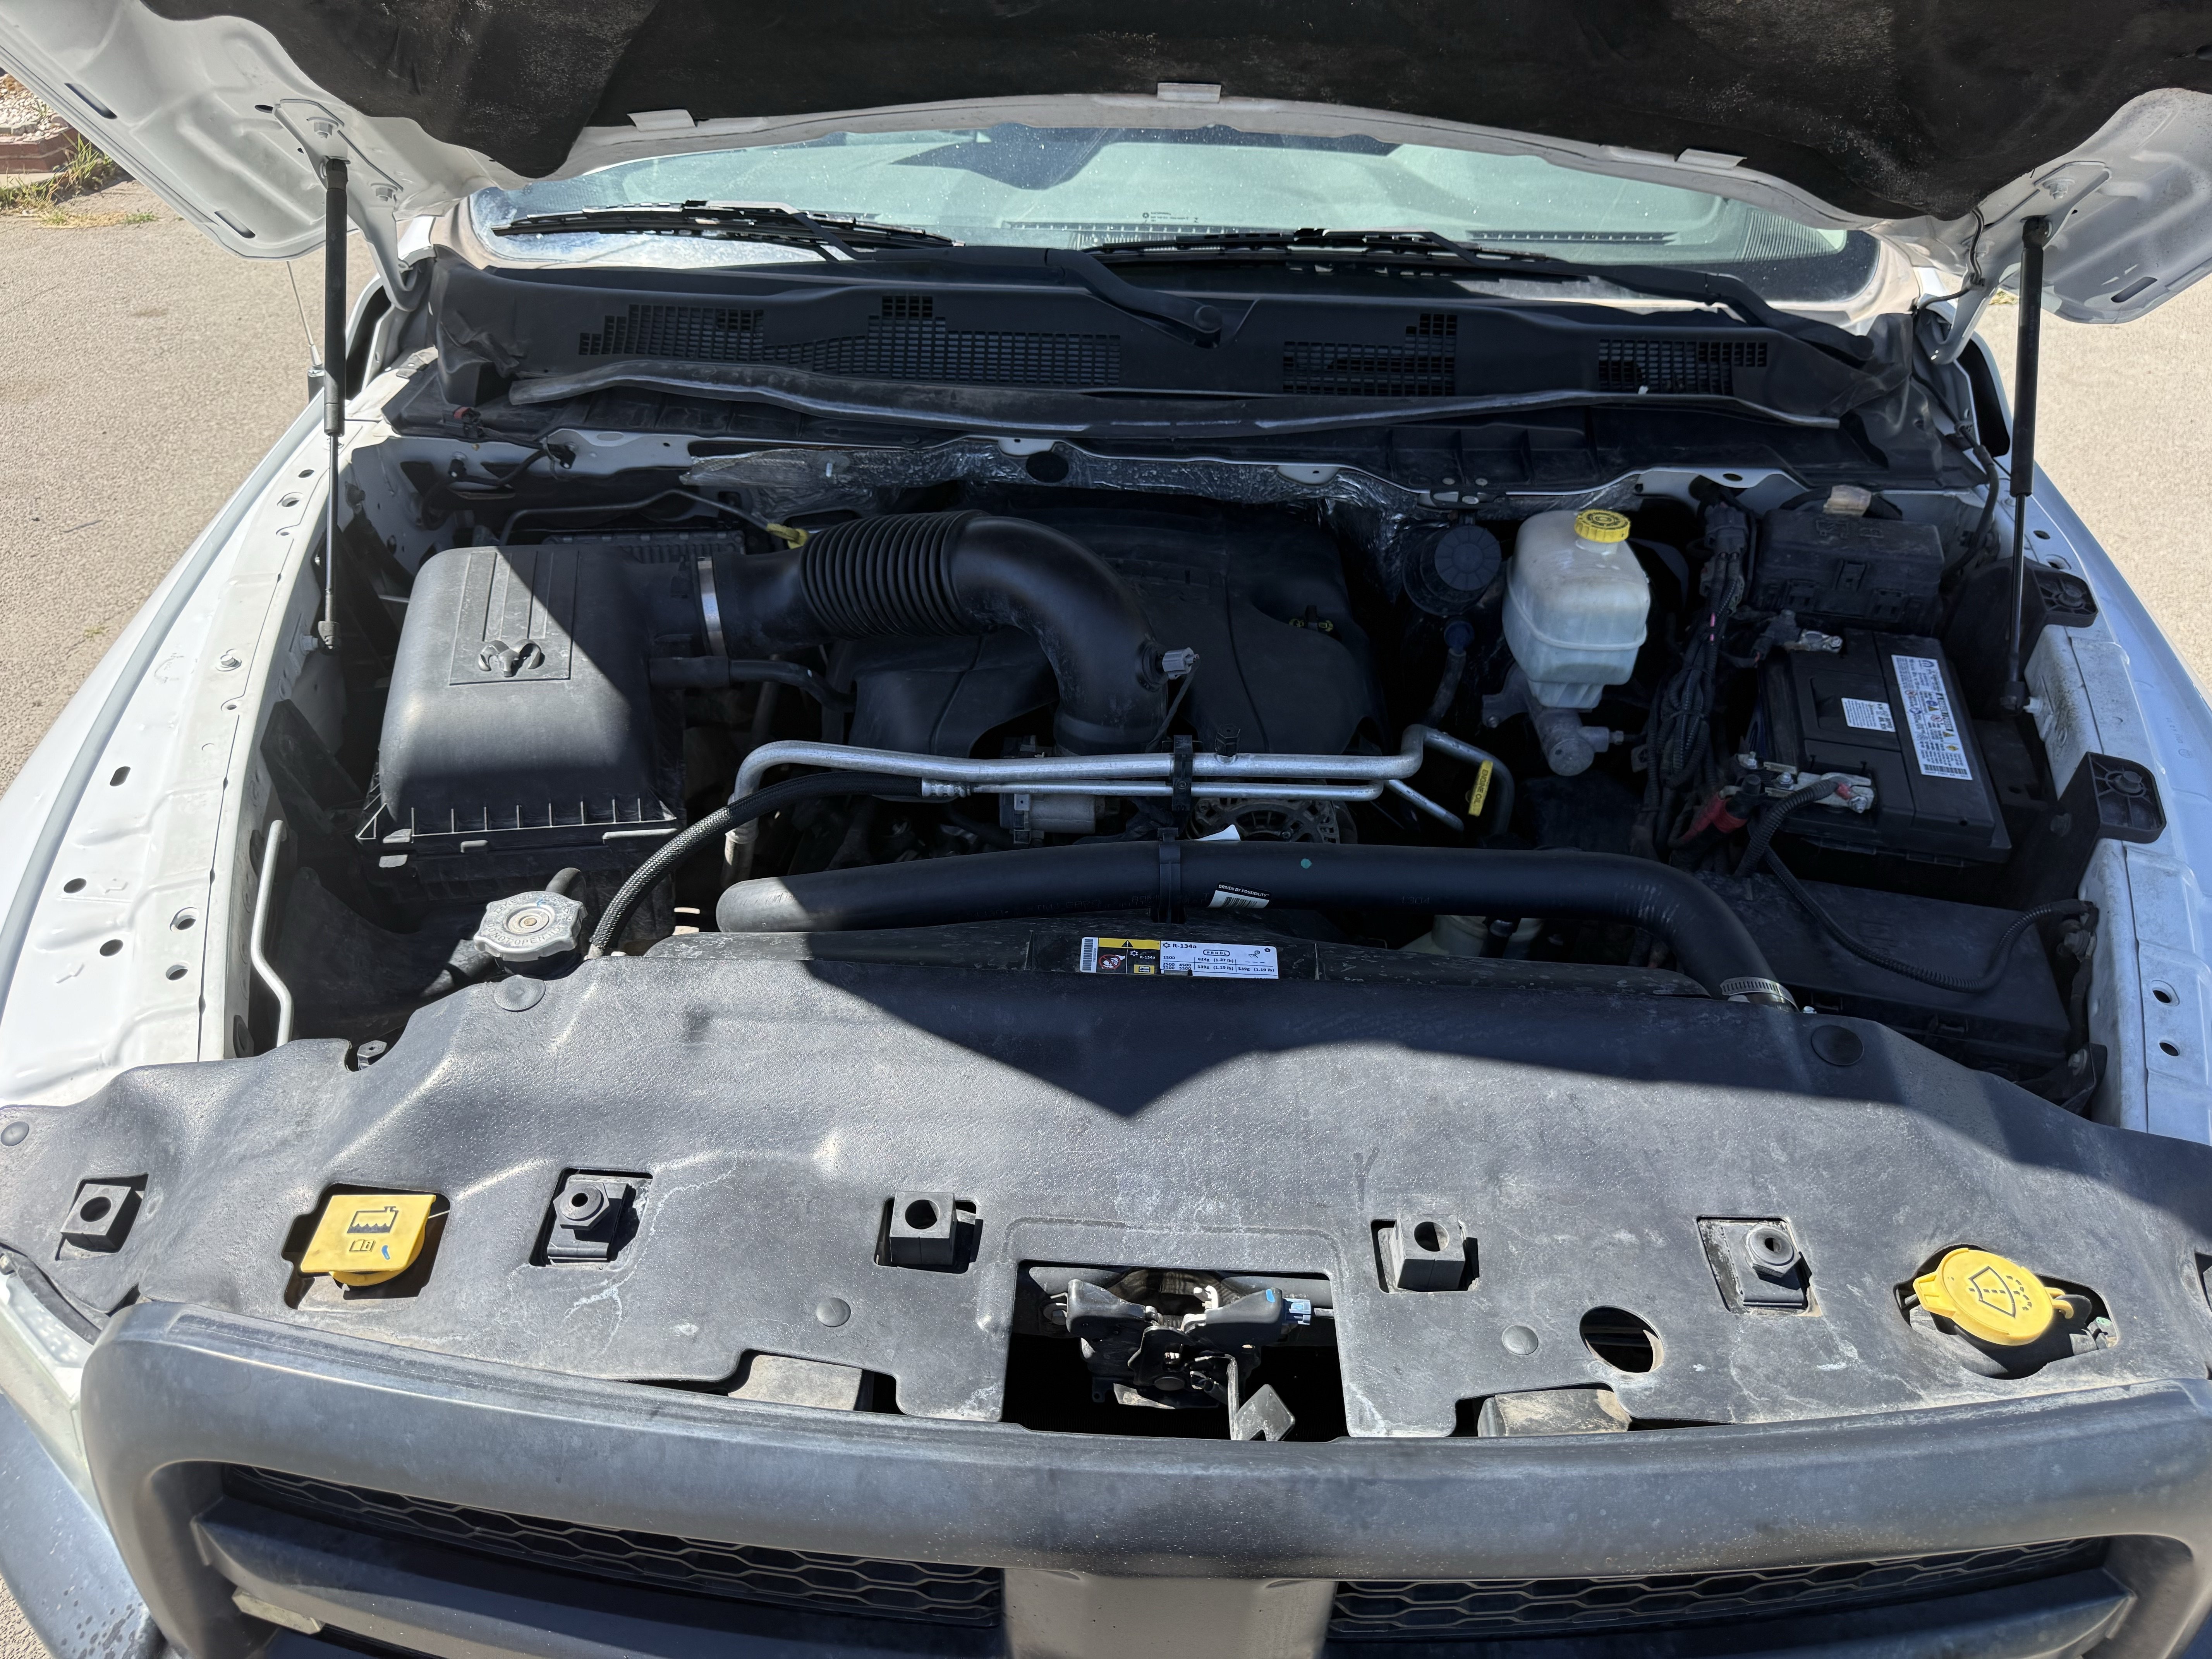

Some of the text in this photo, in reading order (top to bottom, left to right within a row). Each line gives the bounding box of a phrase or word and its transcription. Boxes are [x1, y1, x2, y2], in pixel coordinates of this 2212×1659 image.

[1474, 769, 1489, 804] ENGINE OIL
[488, 923, 567, 946] DO NOT OPEN HOT
